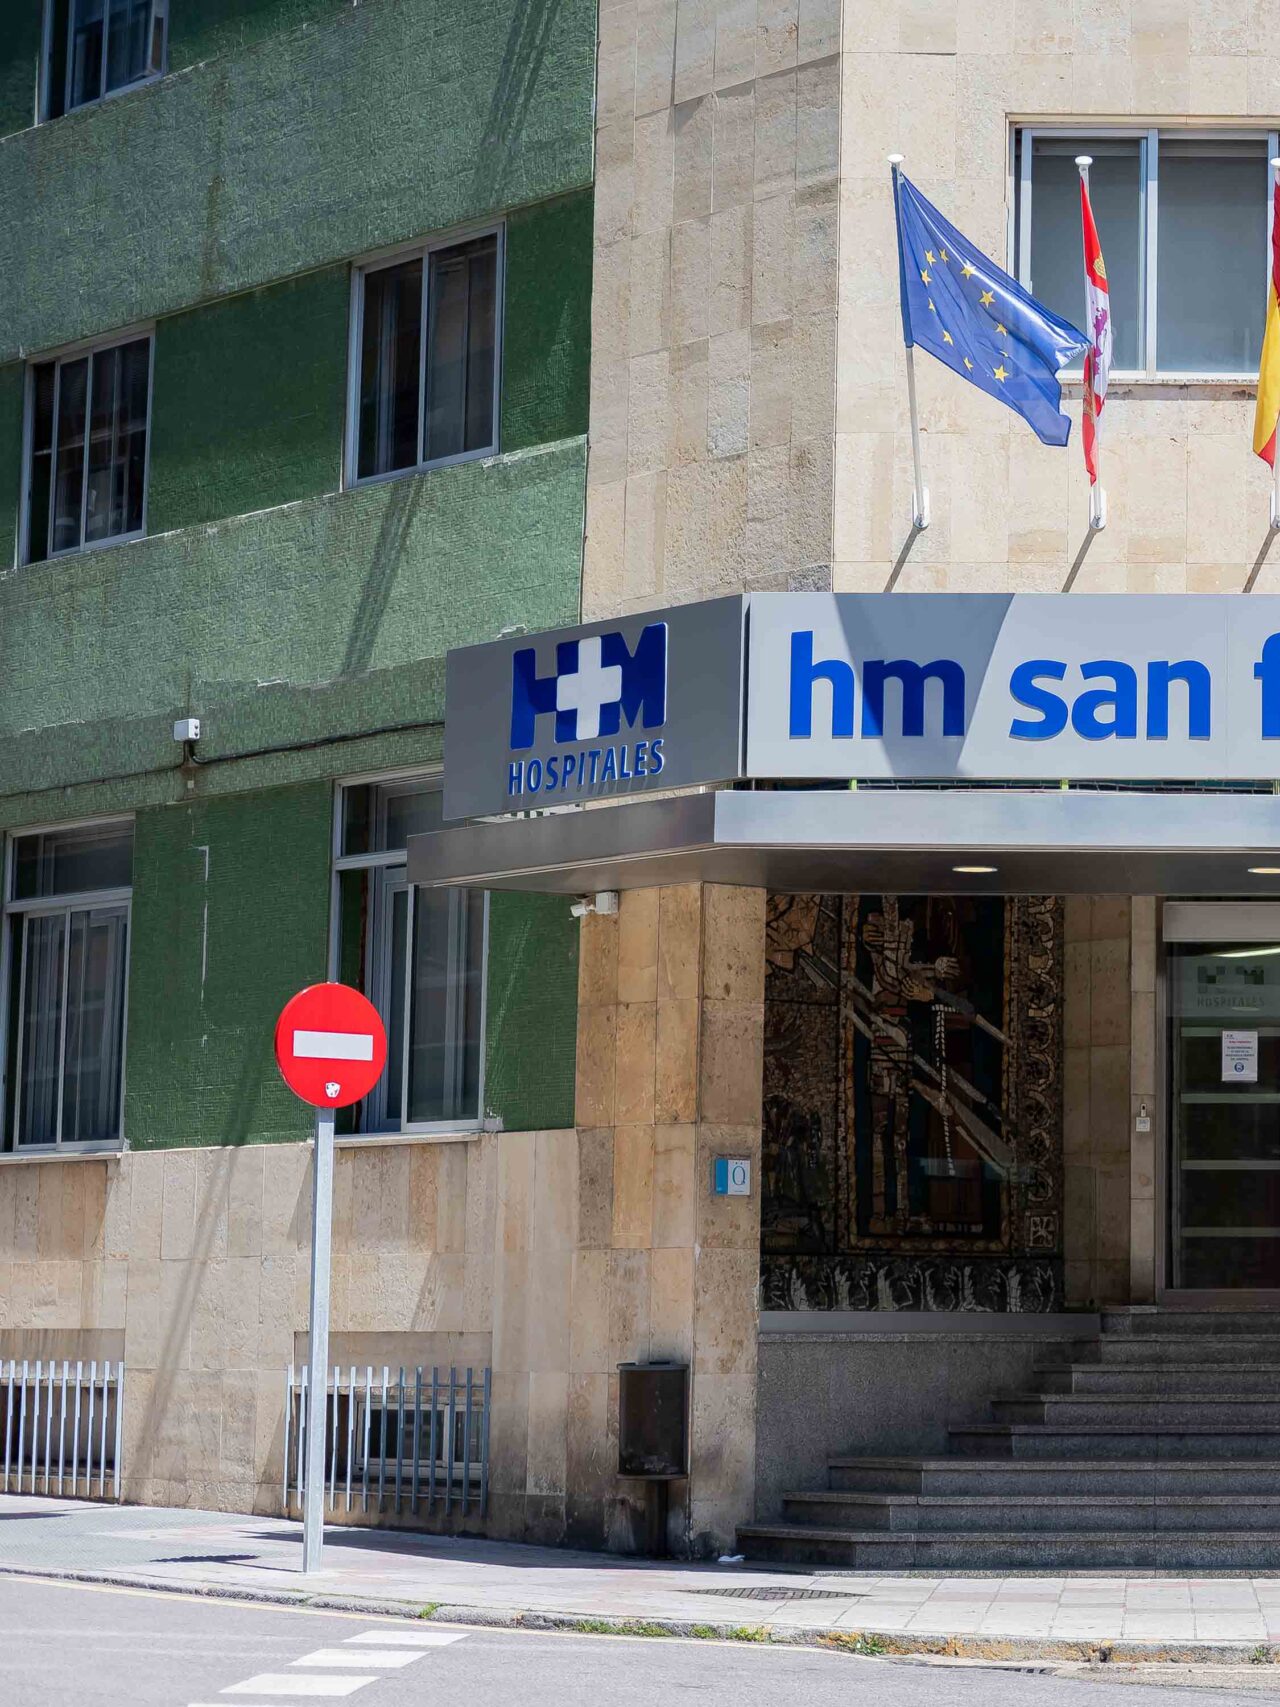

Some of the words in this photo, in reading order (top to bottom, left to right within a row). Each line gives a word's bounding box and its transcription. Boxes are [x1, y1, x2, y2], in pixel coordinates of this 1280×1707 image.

[788, 630, 966, 740] hm
[1008, 659, 1212, 742] san
[508, 738, 666, 796] HOSPITALES
